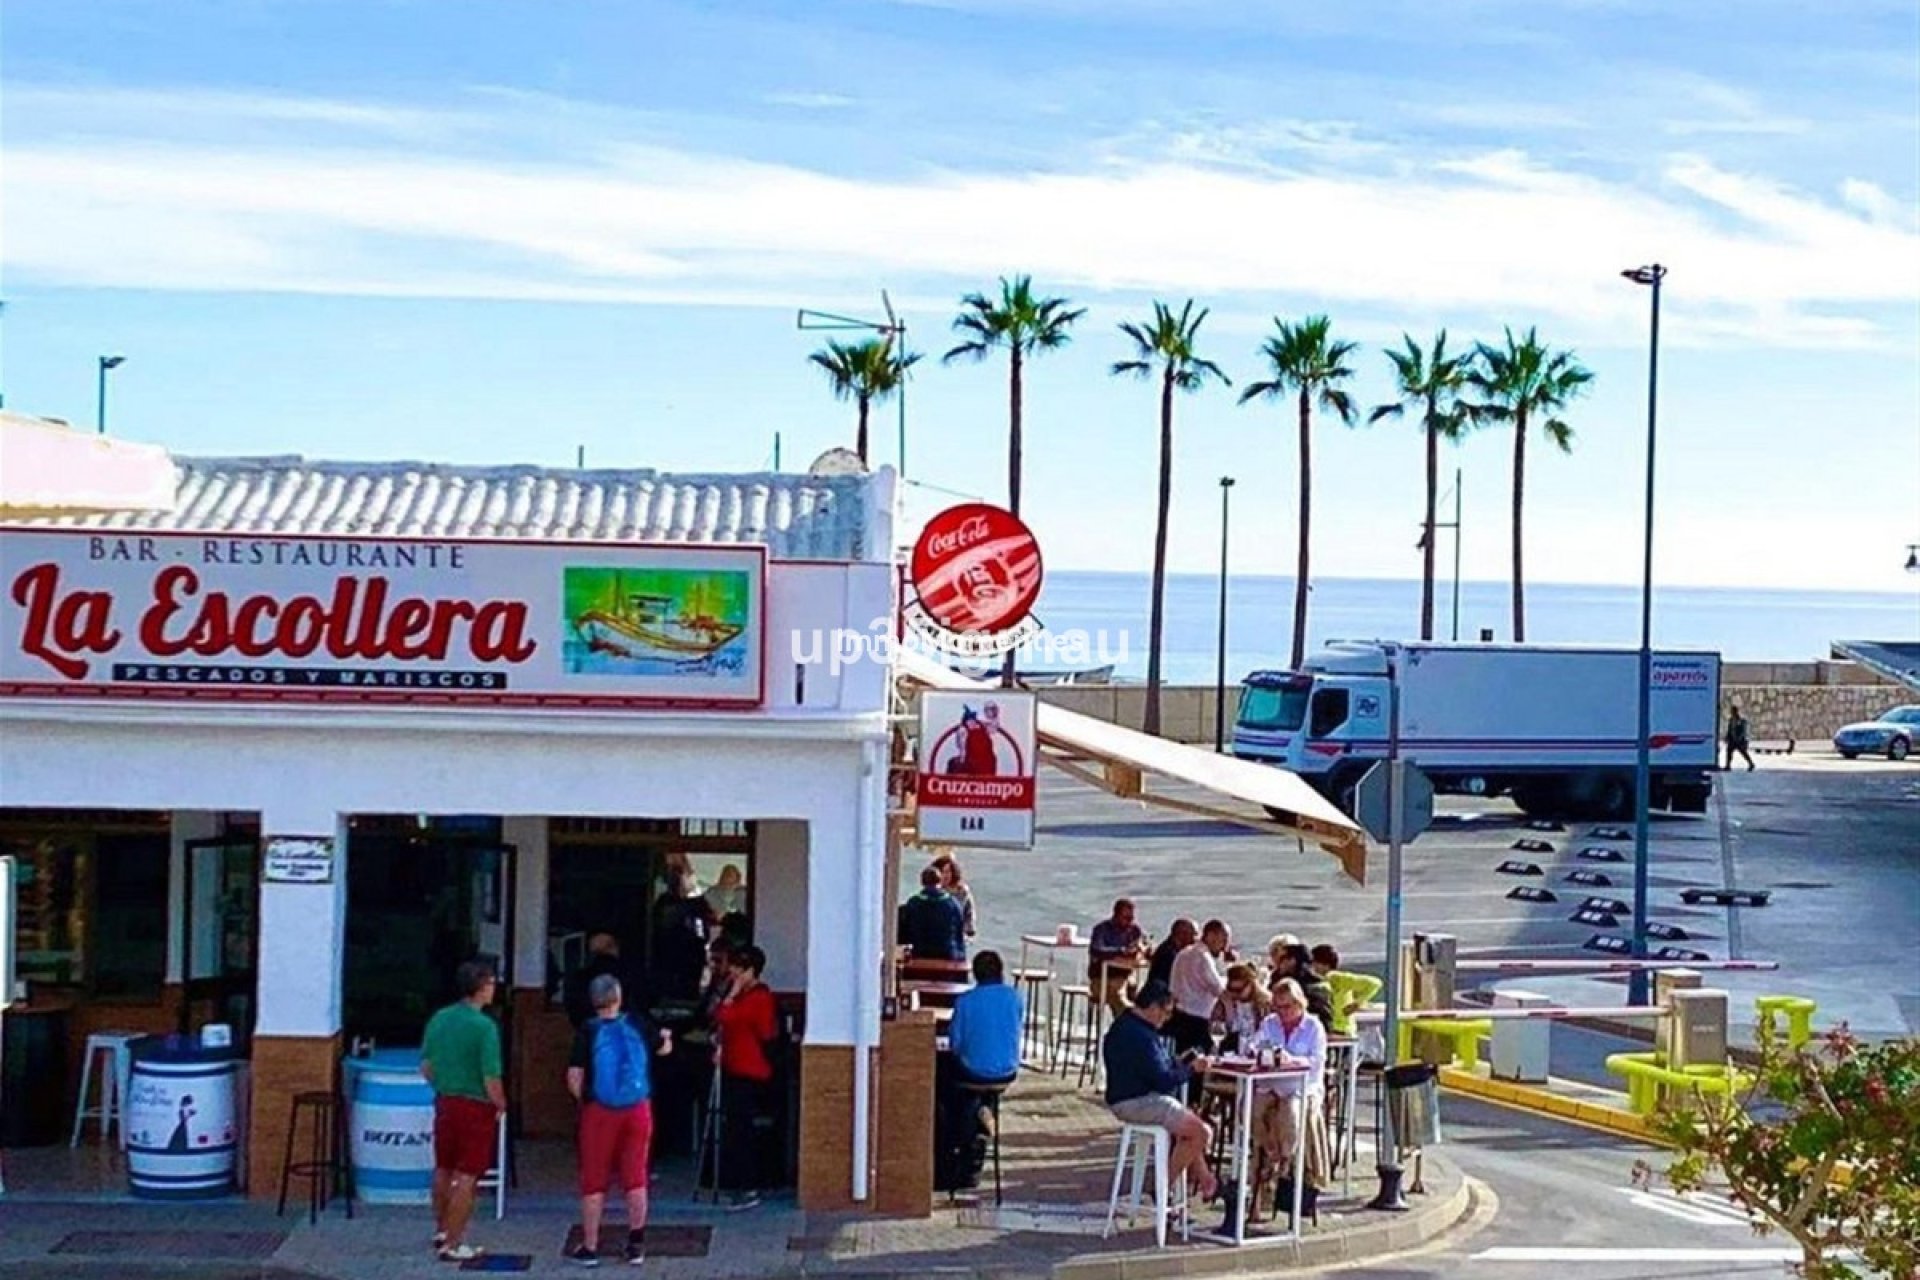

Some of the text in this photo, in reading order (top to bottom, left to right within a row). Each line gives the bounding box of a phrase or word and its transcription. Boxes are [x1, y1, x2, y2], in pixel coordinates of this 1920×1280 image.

[90, 537, 158, 561] BAR
[203, 540, 464, 568] RESTAURANTE
[12, 562, 537, 680] La Escollera
[126, 668, 495, 686] PESCADOS Y MARISCOS
[927, 777, 1024, 800] Cruzcampo
[961, 816, 984, 830] BAR
